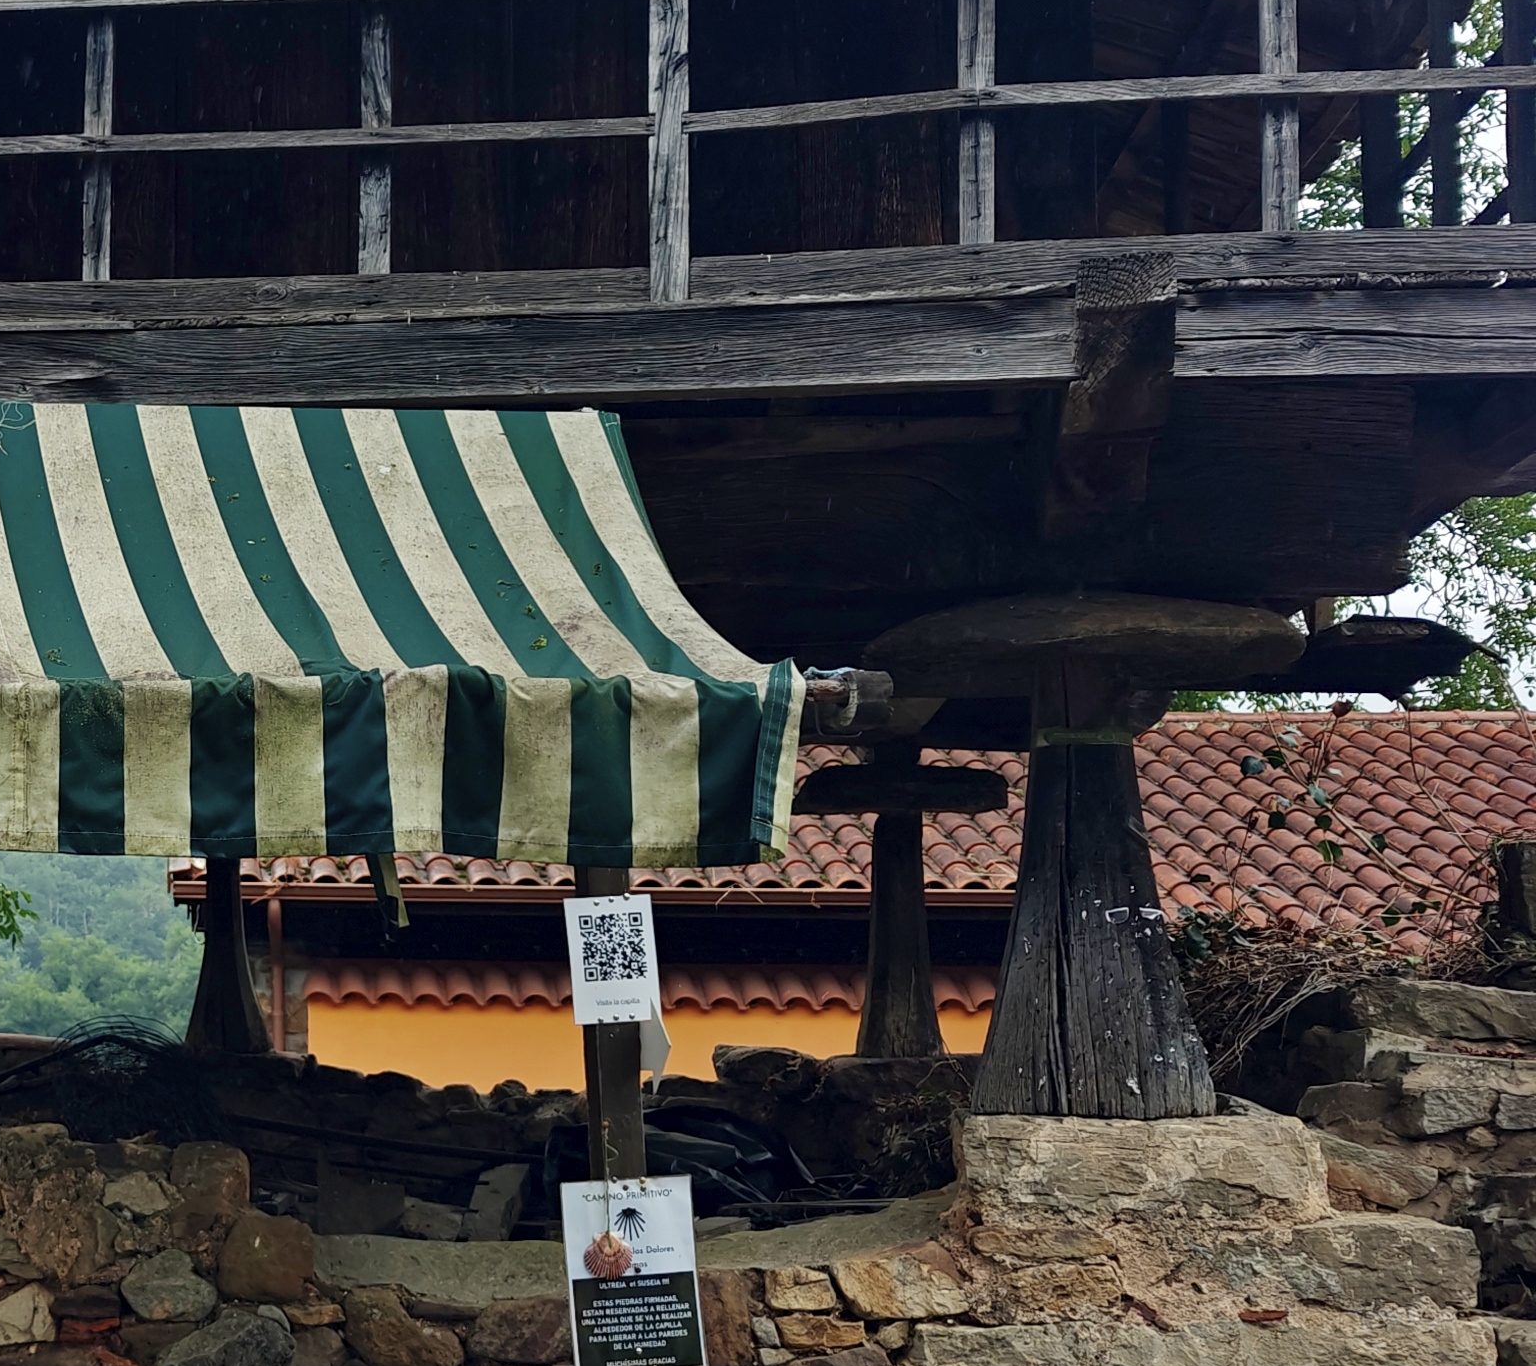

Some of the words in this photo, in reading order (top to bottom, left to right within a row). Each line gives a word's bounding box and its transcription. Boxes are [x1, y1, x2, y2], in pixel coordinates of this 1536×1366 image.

[646, 1245, 674, 1254] Dolores
[599, 1281, 626, 1290] ULTREIA
[637, 1278, 661, 1287] SUSEIA
[593, 1299, 614, 1308] ESTAS
[615, 1298, 643, 1306] PIEDRAS
[582, 1309, 604, 1317] ESTAN
[605, 1306, 649, 1316] RESERVADAS
[656, 1302, 690, 1312] RELLENAR
[581, 1318, 596, 1326] UNA
[597, 1317, 619, 1325] ZANJA
[620, 1316, 633, 1324] QUE
[635, 1315, 644, 1323] SE
[645, 1314, 654, 1322] VA
[661, 1311, 692, 1320] REALIZAR
[593, 1324, 633, 1334] ALREDEDOR
[634, 1323, 644, 1331] DE
[645, 1322, 654, 1330] LA
[655, 1321, 683, 1330] CAPILLA
[589, 1335, 607, 1344] PARA
[608, 1333, 636, 1342] LIBERAR
[644, 1331, 657, 1340] LAS
[658, 1329, 688, 1338] PAREDES
[613, 1343, 622, 1351] DE
[623, 1342, 632, 1350] LA
[648, 1356, 676, 1366] GRACIAS
